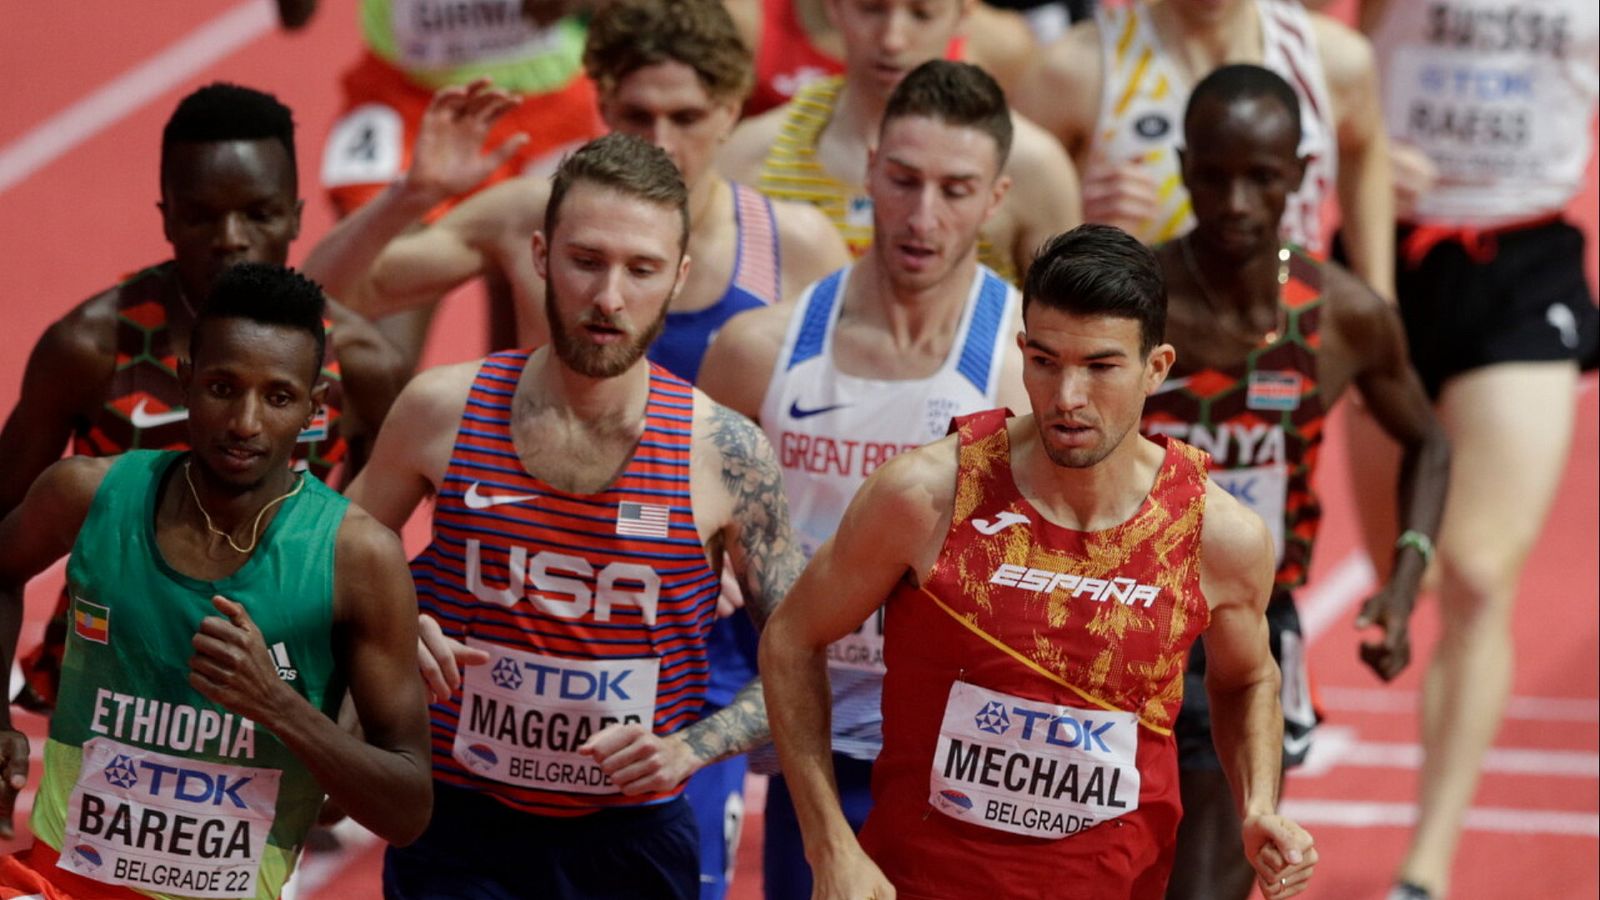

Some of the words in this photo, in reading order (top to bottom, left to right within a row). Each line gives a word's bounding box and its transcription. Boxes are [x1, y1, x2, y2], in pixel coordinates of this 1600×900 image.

[778, 431, 861, 477] GREAT
[465, 538, 661, 626] USA
[990, 563, 1162, 608] ESPAÑA
[524, 661, 635, 702] TDK
[90, 687, 255, 759] ETHIOPIA
[1012, 706, 1116, 753] TDK
[140, 760, 253, 810] TDK
[943, 738, 1127, 808] MECHAAL
[78, 793, 251, 860] BAREGA
[113, 857, 222, 892] BELGRADE
[225, 871, 251, 892] 22
